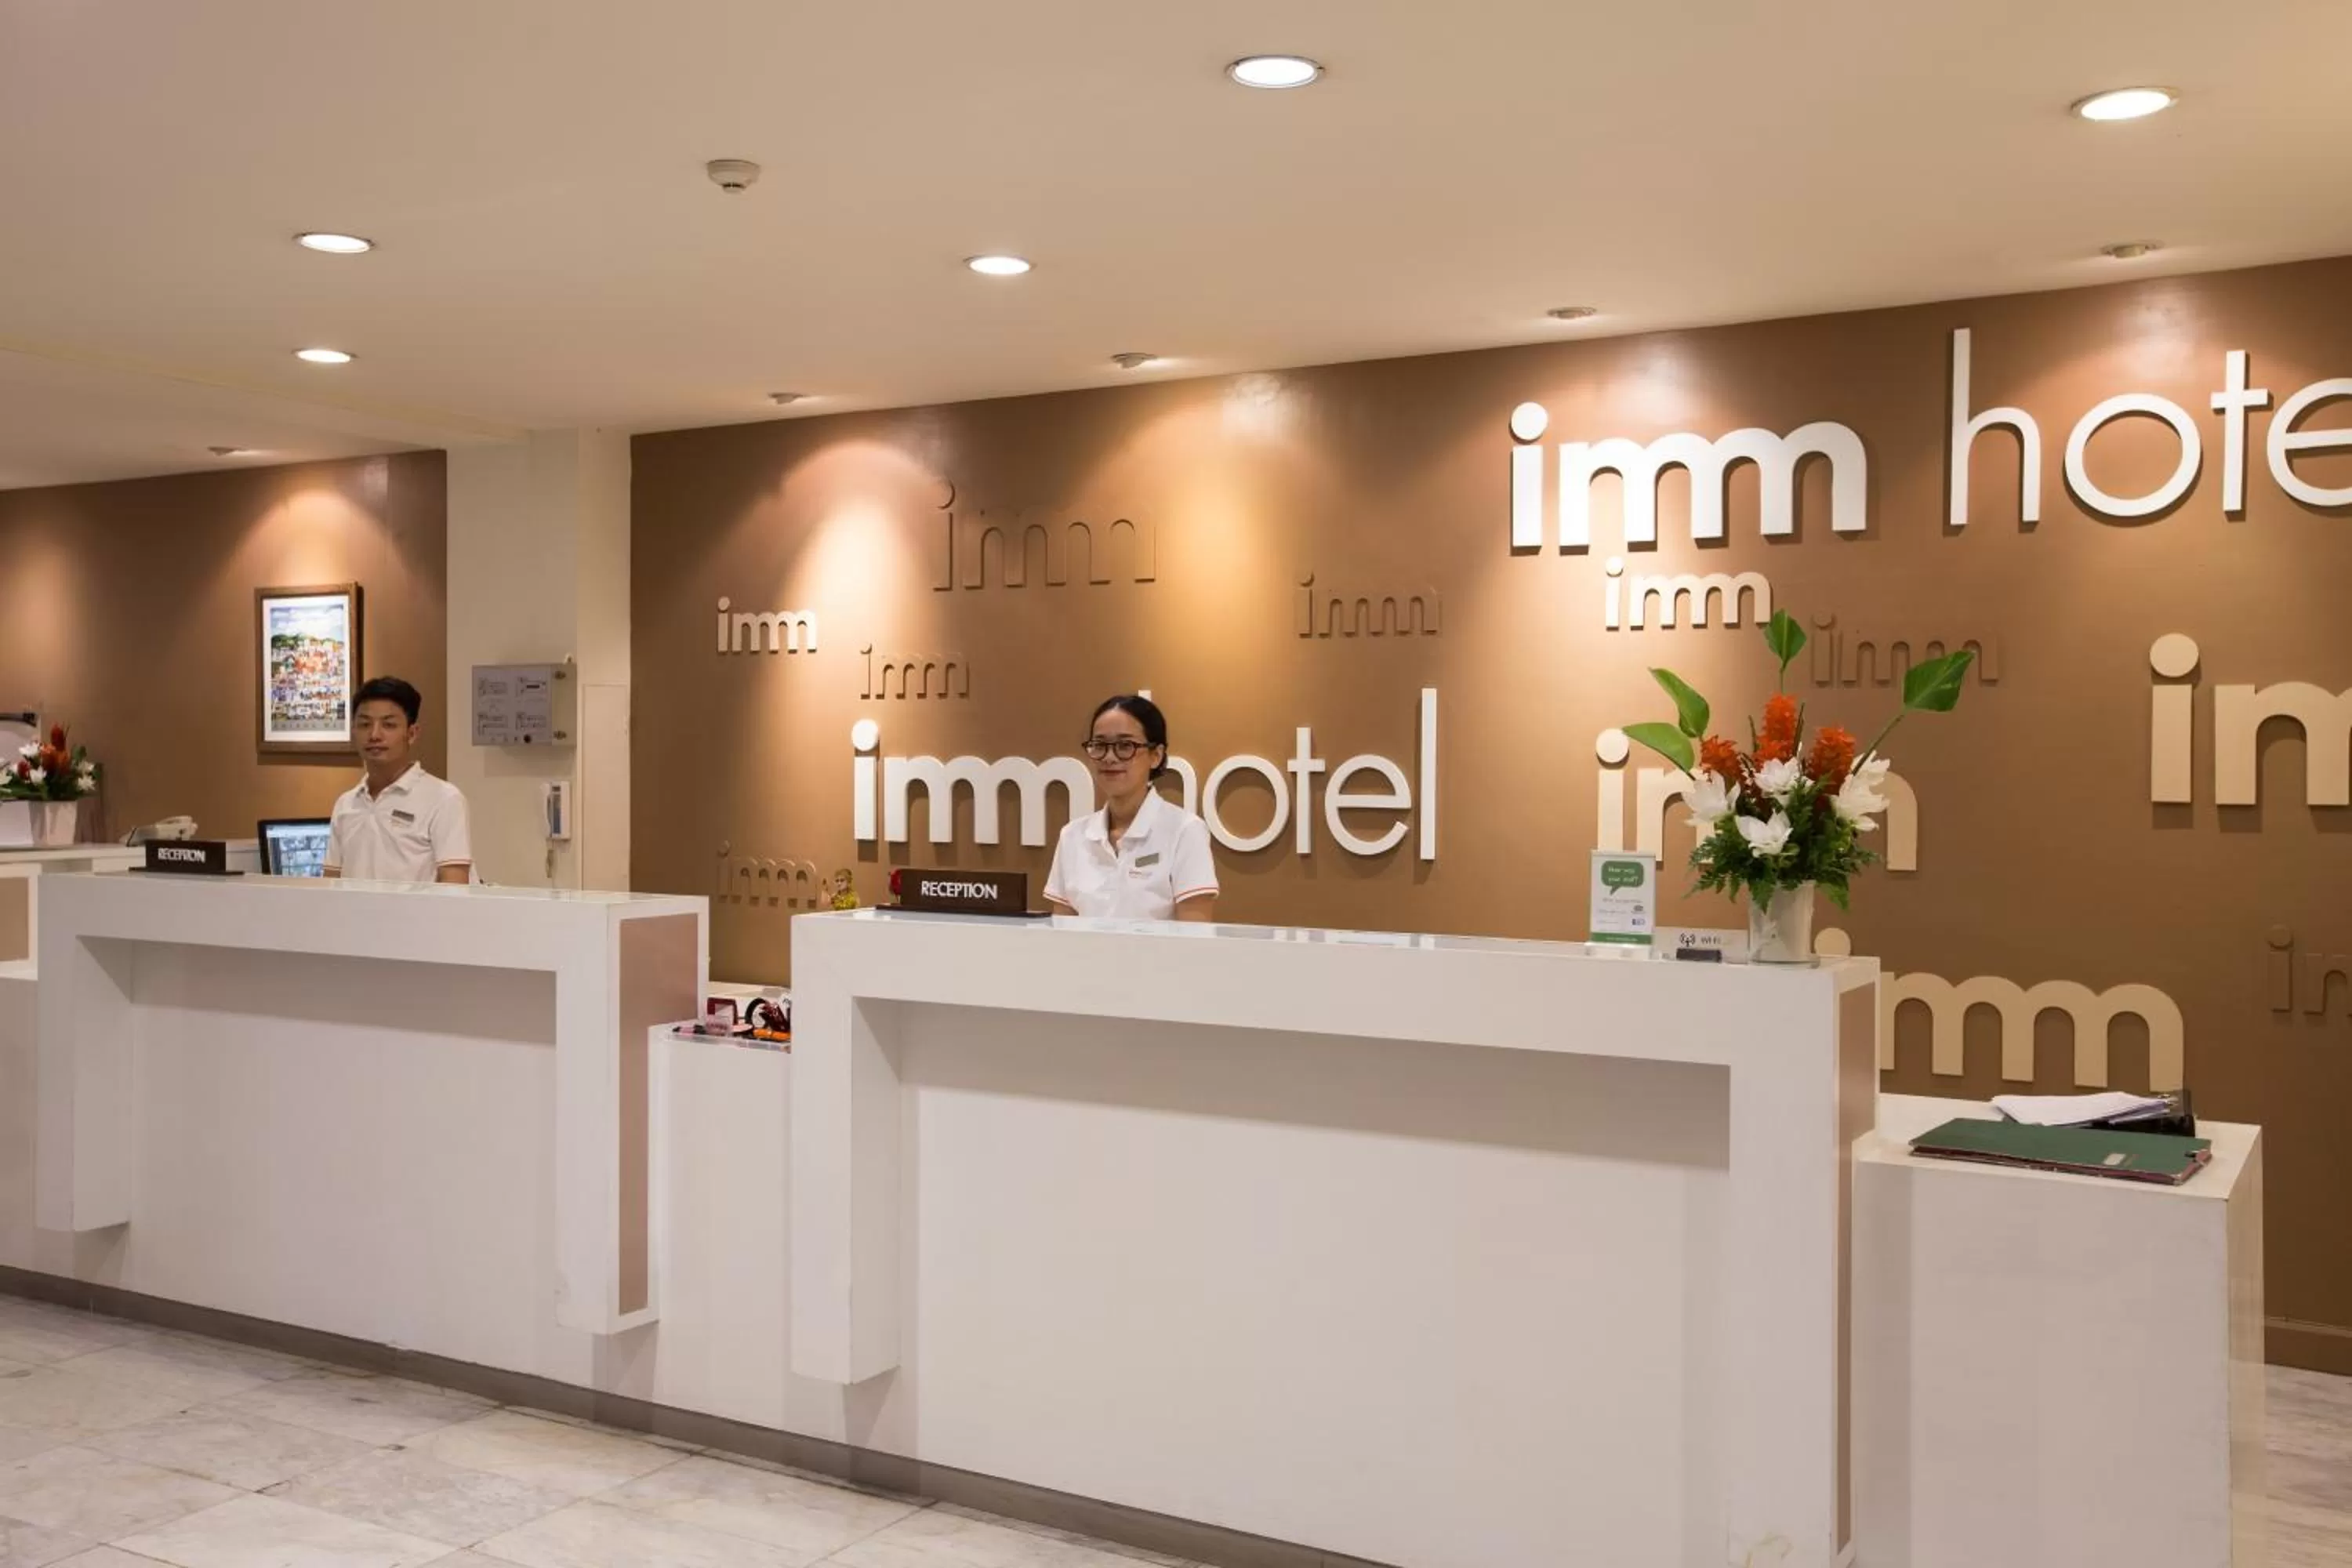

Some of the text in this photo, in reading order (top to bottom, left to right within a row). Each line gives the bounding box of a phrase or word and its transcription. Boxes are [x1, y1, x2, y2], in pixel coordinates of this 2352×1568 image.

[1512, 328, 2352, 548] imm hote
[717, 596, 817, 654] imm
[1605, 556, 1772, 630] imm
[851, 719, 1094, 846] imm
[158, 848, 205, 863] RECEPTION
[920, 880, 998, 899] RECEPTION
[1813, 927, 2183, 1092] mm
